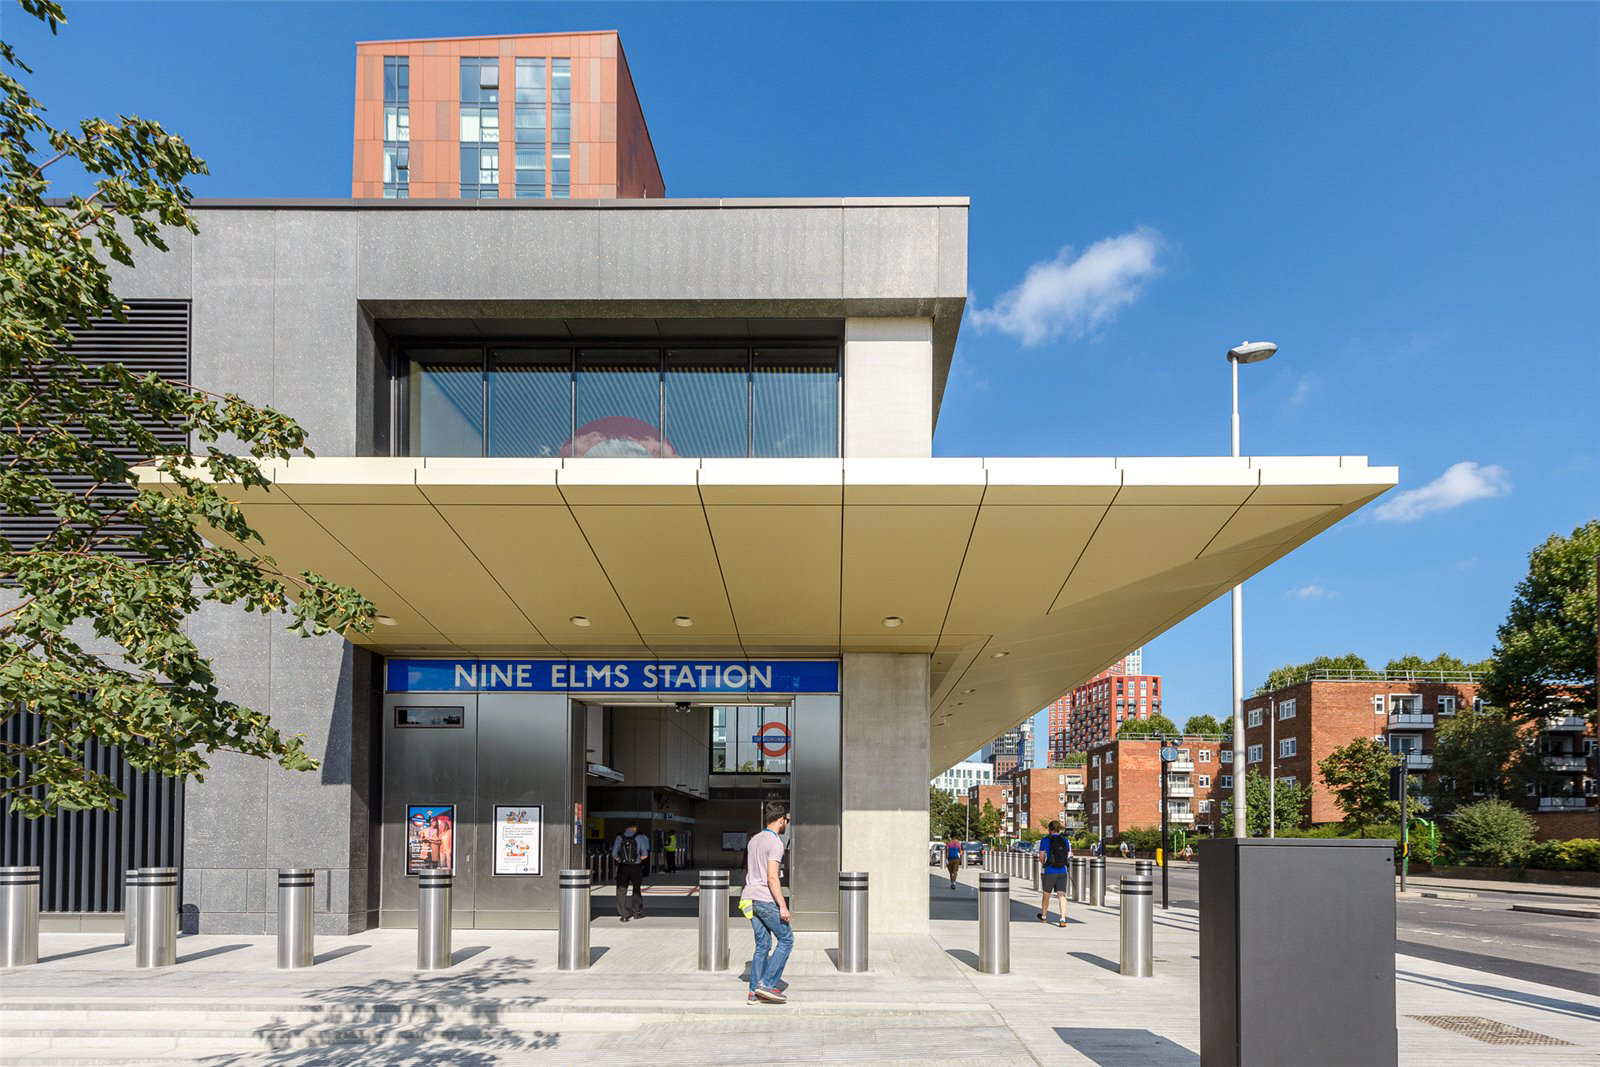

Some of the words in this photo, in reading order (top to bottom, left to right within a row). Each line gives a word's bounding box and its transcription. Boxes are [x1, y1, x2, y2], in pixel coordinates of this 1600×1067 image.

[455, 664, 532, 687] NINE
[551, 664, 630, 688] ELMS
[642, 665, 772, 688] STATION
